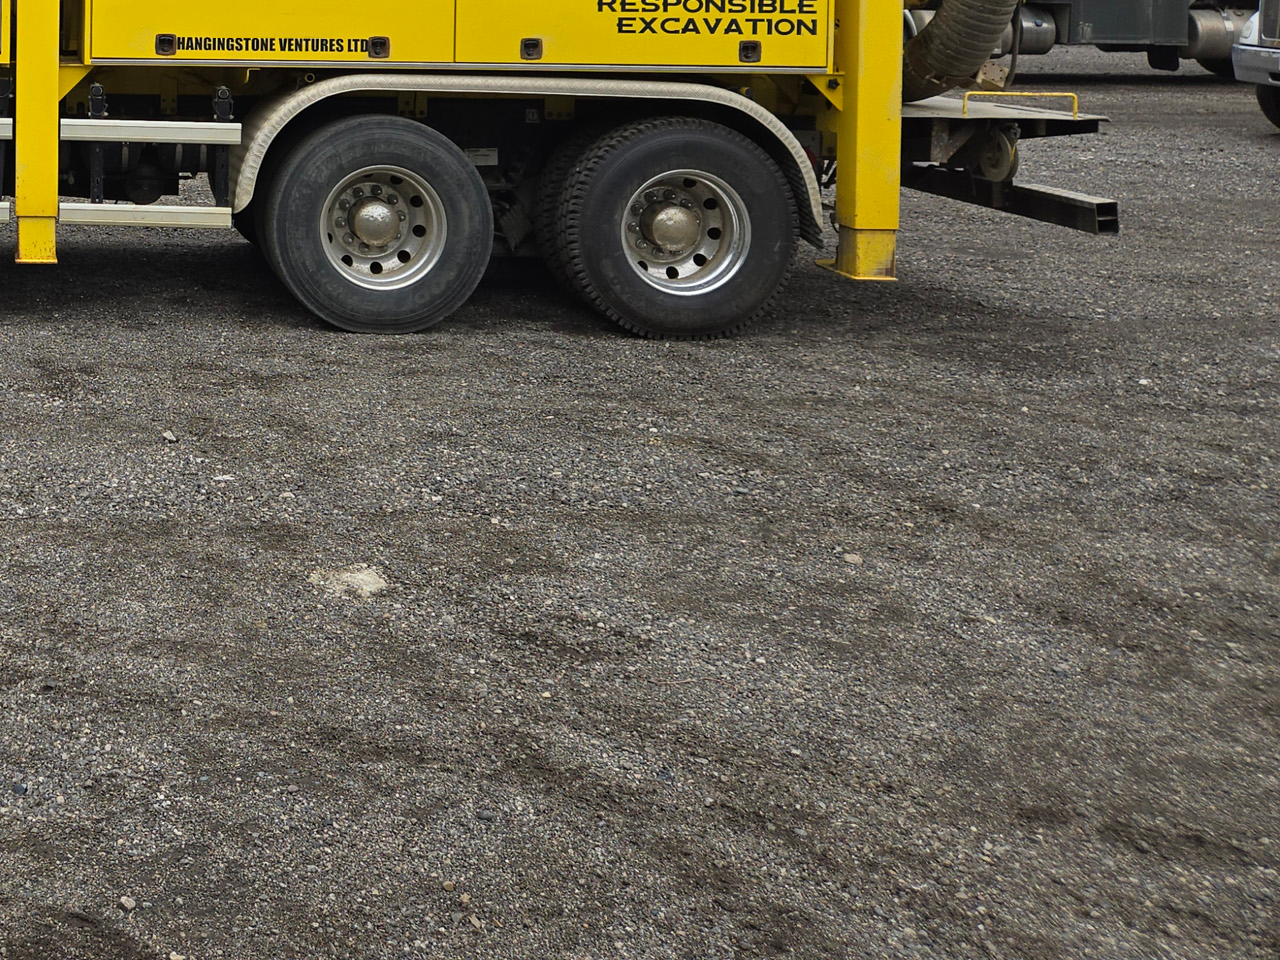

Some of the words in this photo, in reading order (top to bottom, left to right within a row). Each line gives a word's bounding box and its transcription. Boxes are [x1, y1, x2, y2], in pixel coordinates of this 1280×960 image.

[616, 17, 818, 36] EXCAVATION
[177, 36, 276, 52] HANGINGSTONE
[278, 37, 344, 53] VENTURES
[347, 38, 369, 53] LTD
